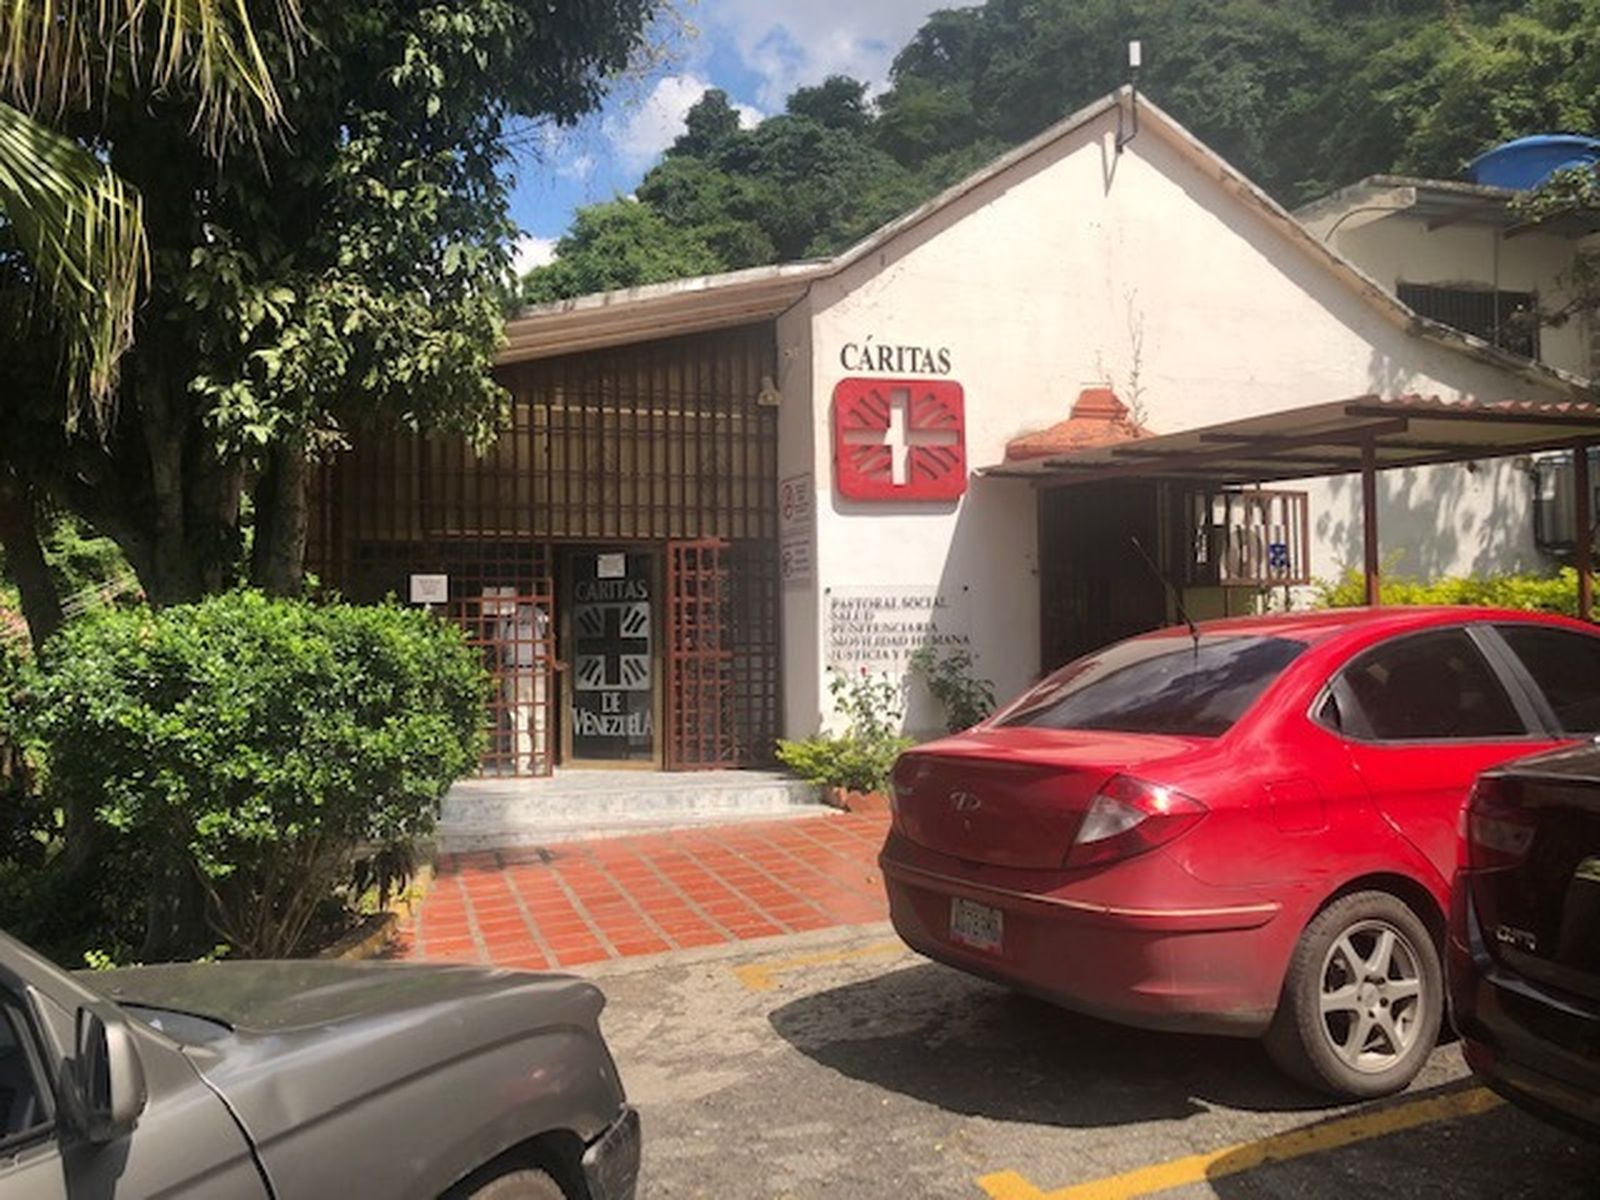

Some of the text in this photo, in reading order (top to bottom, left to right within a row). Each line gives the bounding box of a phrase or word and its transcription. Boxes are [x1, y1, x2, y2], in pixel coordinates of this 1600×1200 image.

[840, 334, 952, 375] CÁRITAS
[831, 597, 948, 609] PASTORAL SOCIAL
[602, 692, 621, 713] DE
[572, 707, 654, 736] VENEZUELA
